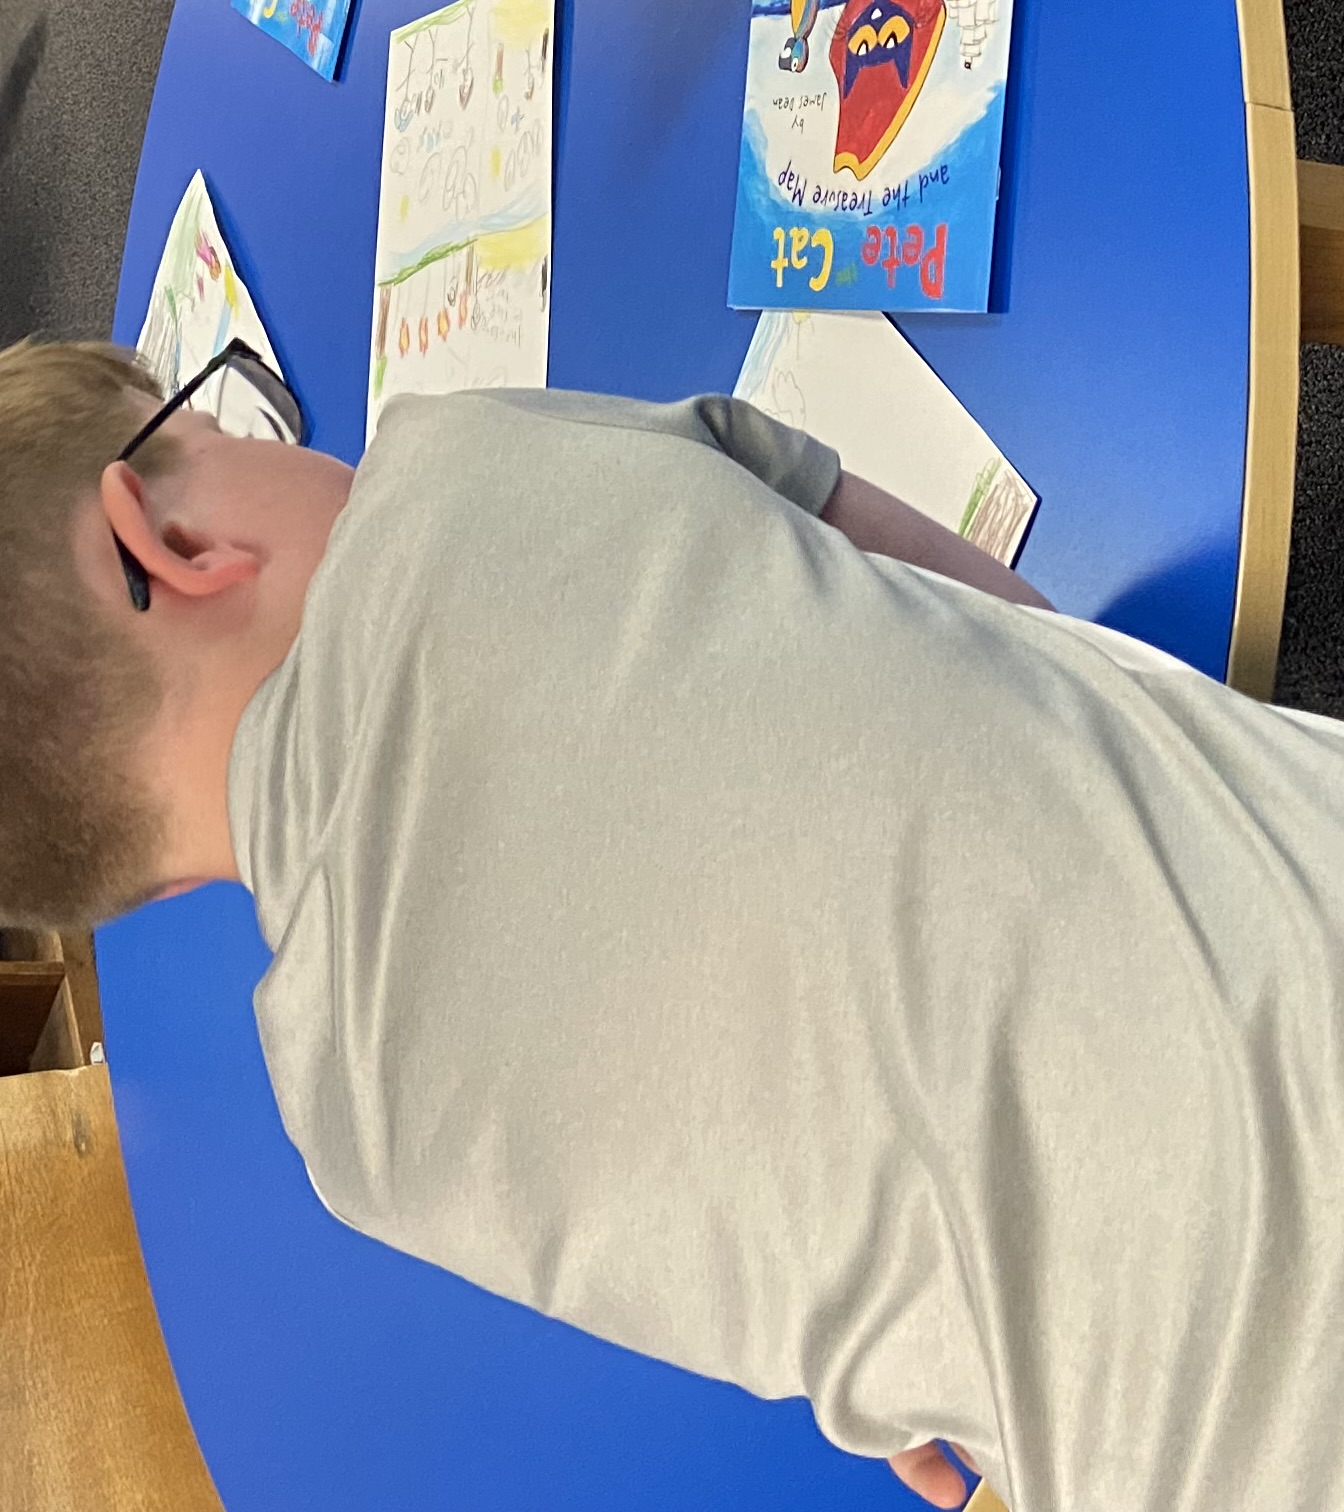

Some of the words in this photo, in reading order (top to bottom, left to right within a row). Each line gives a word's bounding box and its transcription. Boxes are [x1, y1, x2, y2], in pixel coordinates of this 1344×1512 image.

[772, 97, 796, 112] Dean
[798, 92, 827, 110] James
[791, 114, 805, 133] by
[777, 160, 808, 206] Map
[881, 183, 915, 211] the
[918, 165, 949, 203] and
[812, 184, 874, 216] Treasure
[770, 227, 834, 291] Cat
[861, 222, 949, 300] Pete
